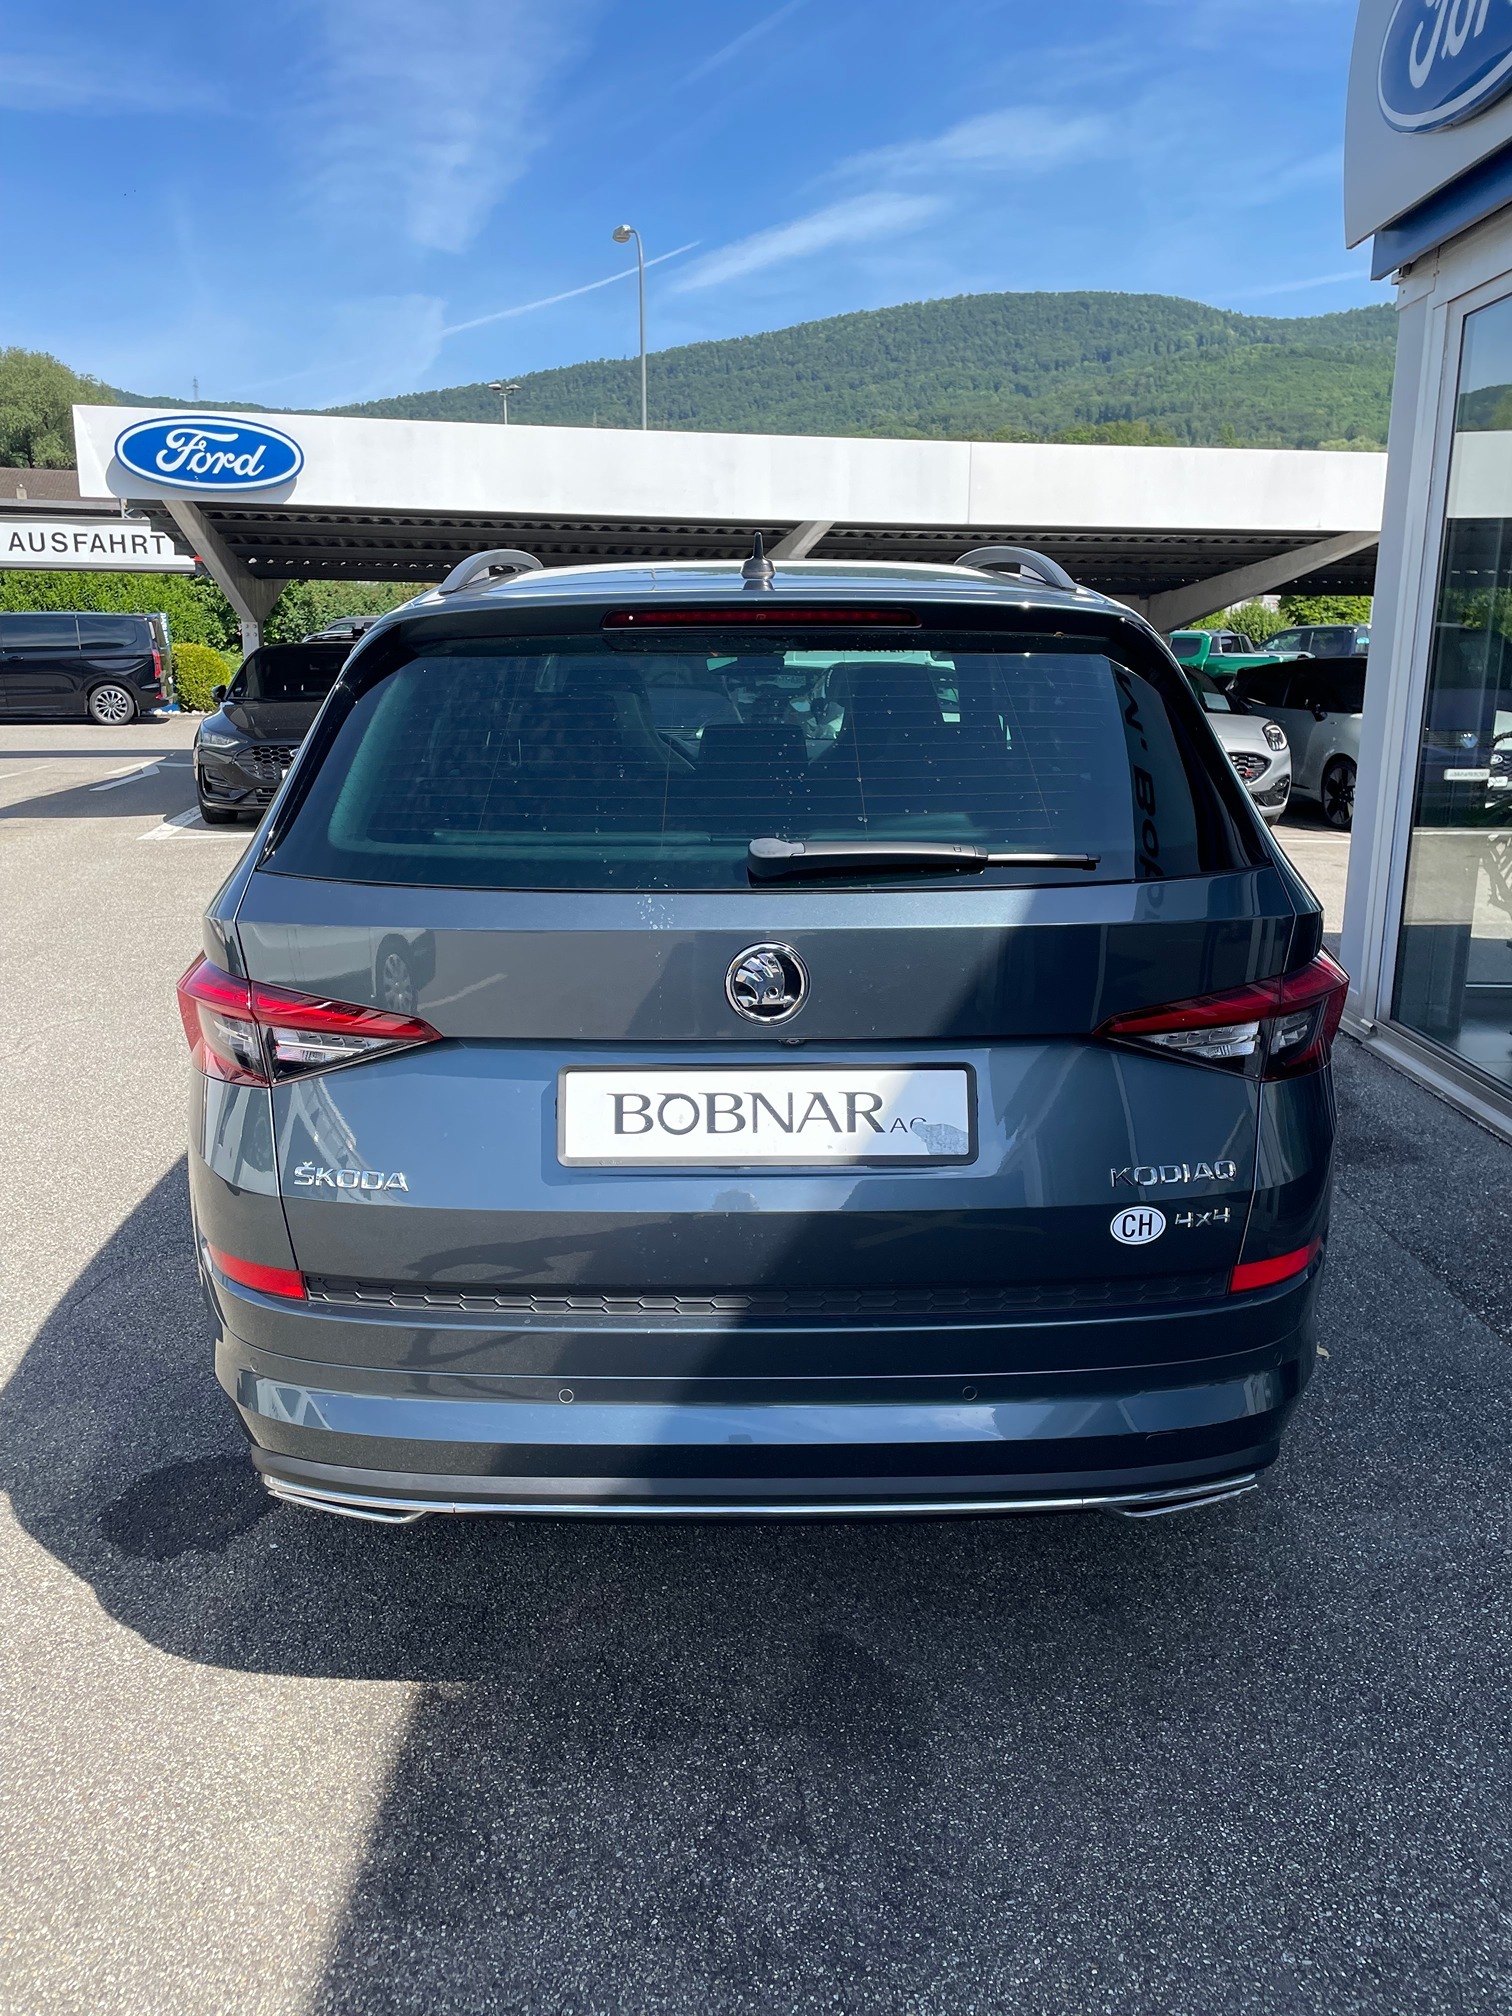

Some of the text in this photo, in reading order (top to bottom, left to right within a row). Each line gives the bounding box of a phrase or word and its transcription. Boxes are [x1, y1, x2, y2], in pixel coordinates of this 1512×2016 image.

[156, 428, 267, 477] Ford
[8, 531, 167, 555] AUSFAHRT
[606, 1091, 886, 1136] BOBNAR
[293, 1161, 409, 1192] ŠKODA
[1110, 1160, 1237, 1188] KODIAQ
[1122, 1213, 1153, 1238] CH
